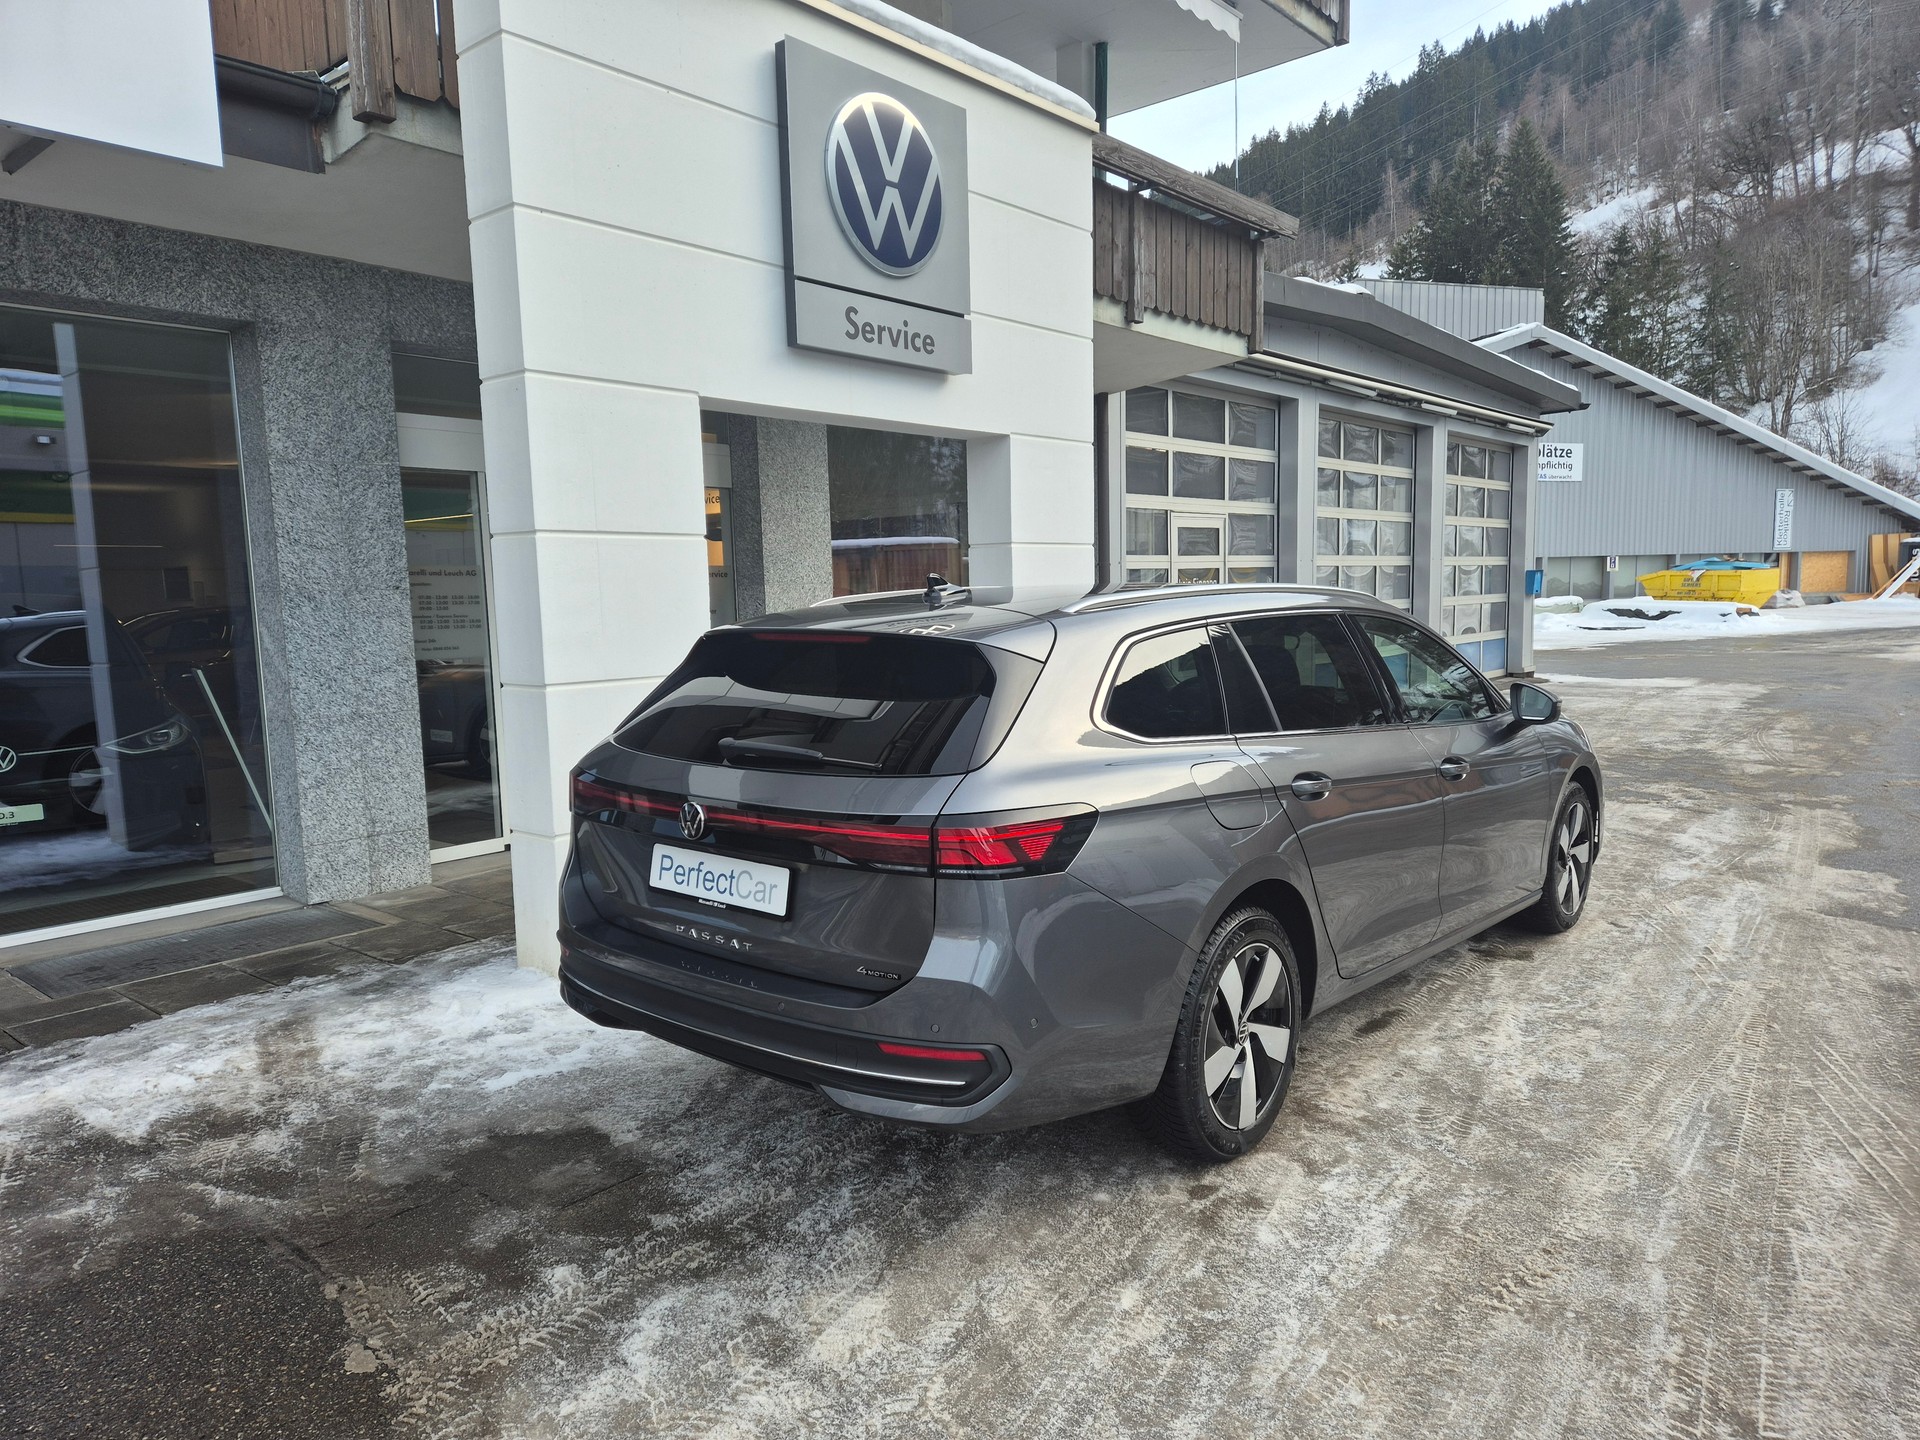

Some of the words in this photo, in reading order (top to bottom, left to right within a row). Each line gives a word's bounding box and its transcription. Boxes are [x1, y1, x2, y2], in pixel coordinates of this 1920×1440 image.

[844, 305, 936, 355] Service
[1776, 492, 1785, 546] Kletterhalle
[659, 854, 778, 905] PerfectCar
[675, 924, 753, 952] PASSAT
